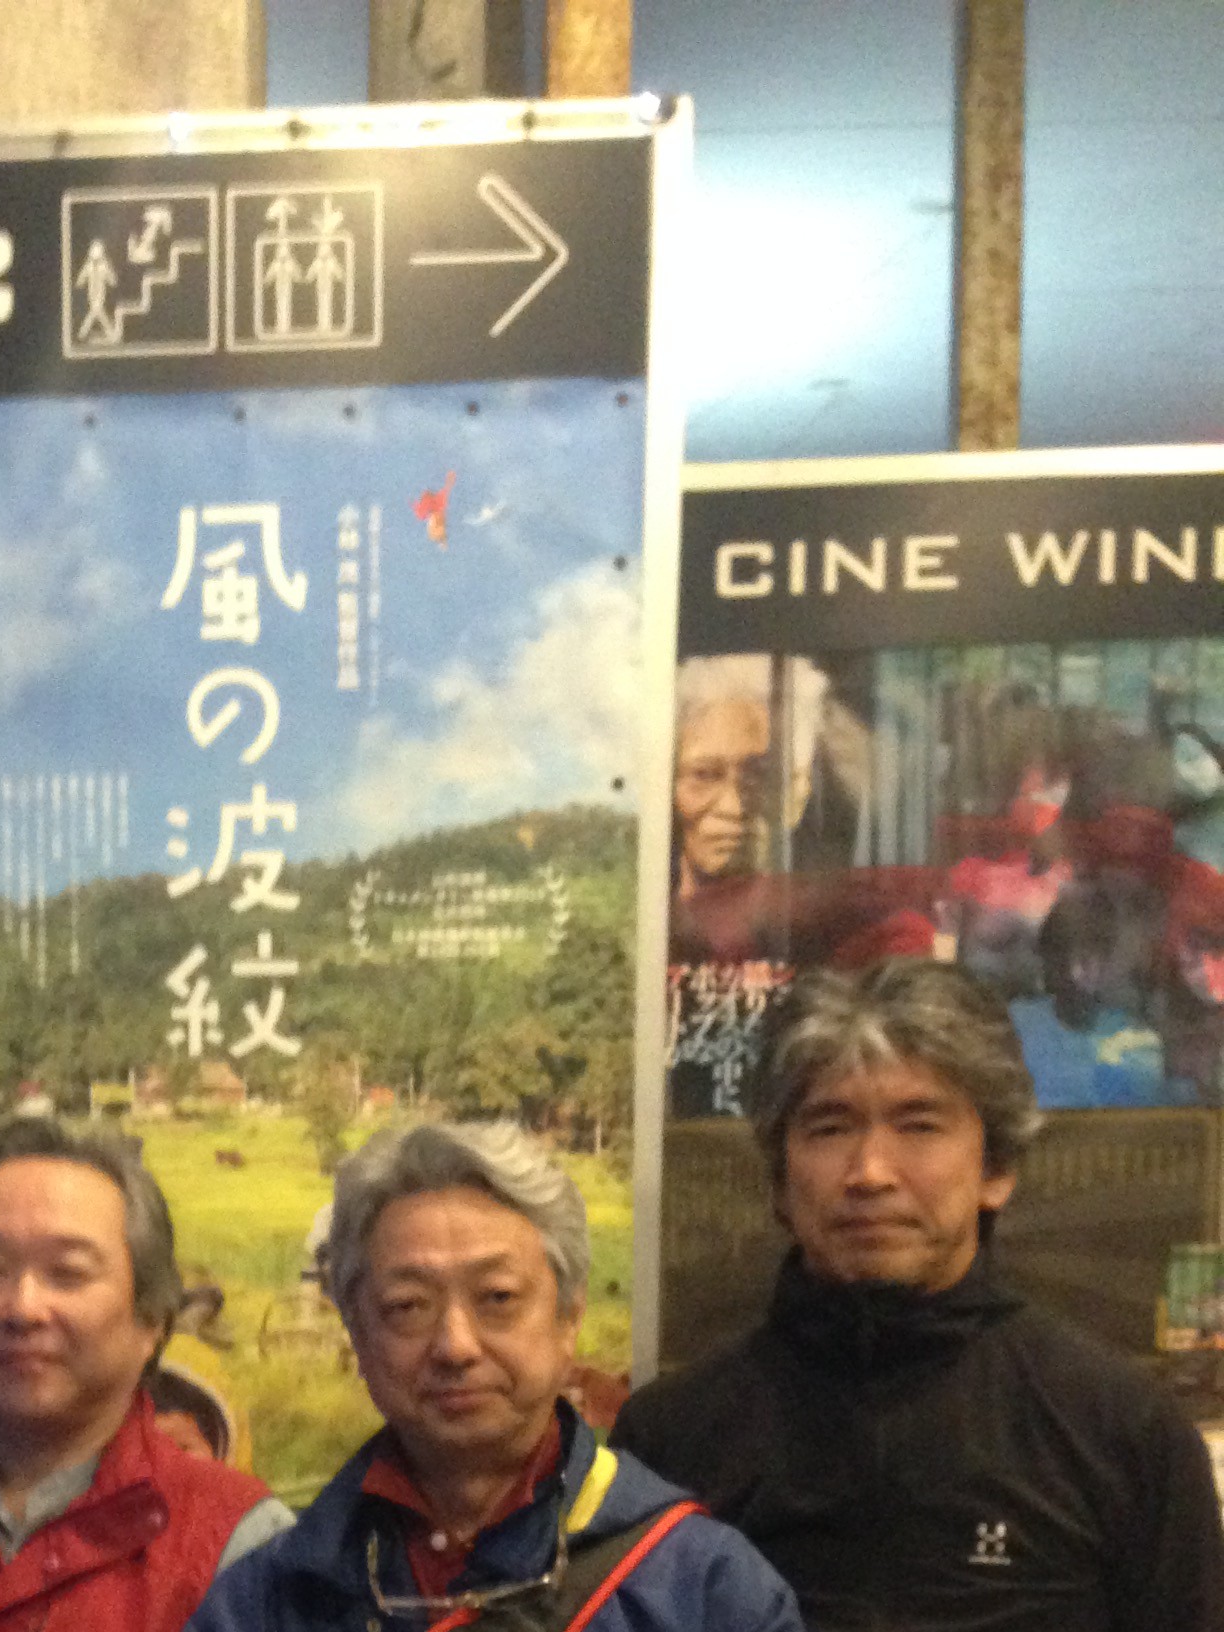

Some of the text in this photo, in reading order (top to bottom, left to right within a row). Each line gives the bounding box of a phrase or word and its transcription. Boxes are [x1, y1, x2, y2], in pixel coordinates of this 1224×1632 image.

[714, 526, 1223, 599] CINE WIN
[160, 502, 309, 1058] 風の波紋
